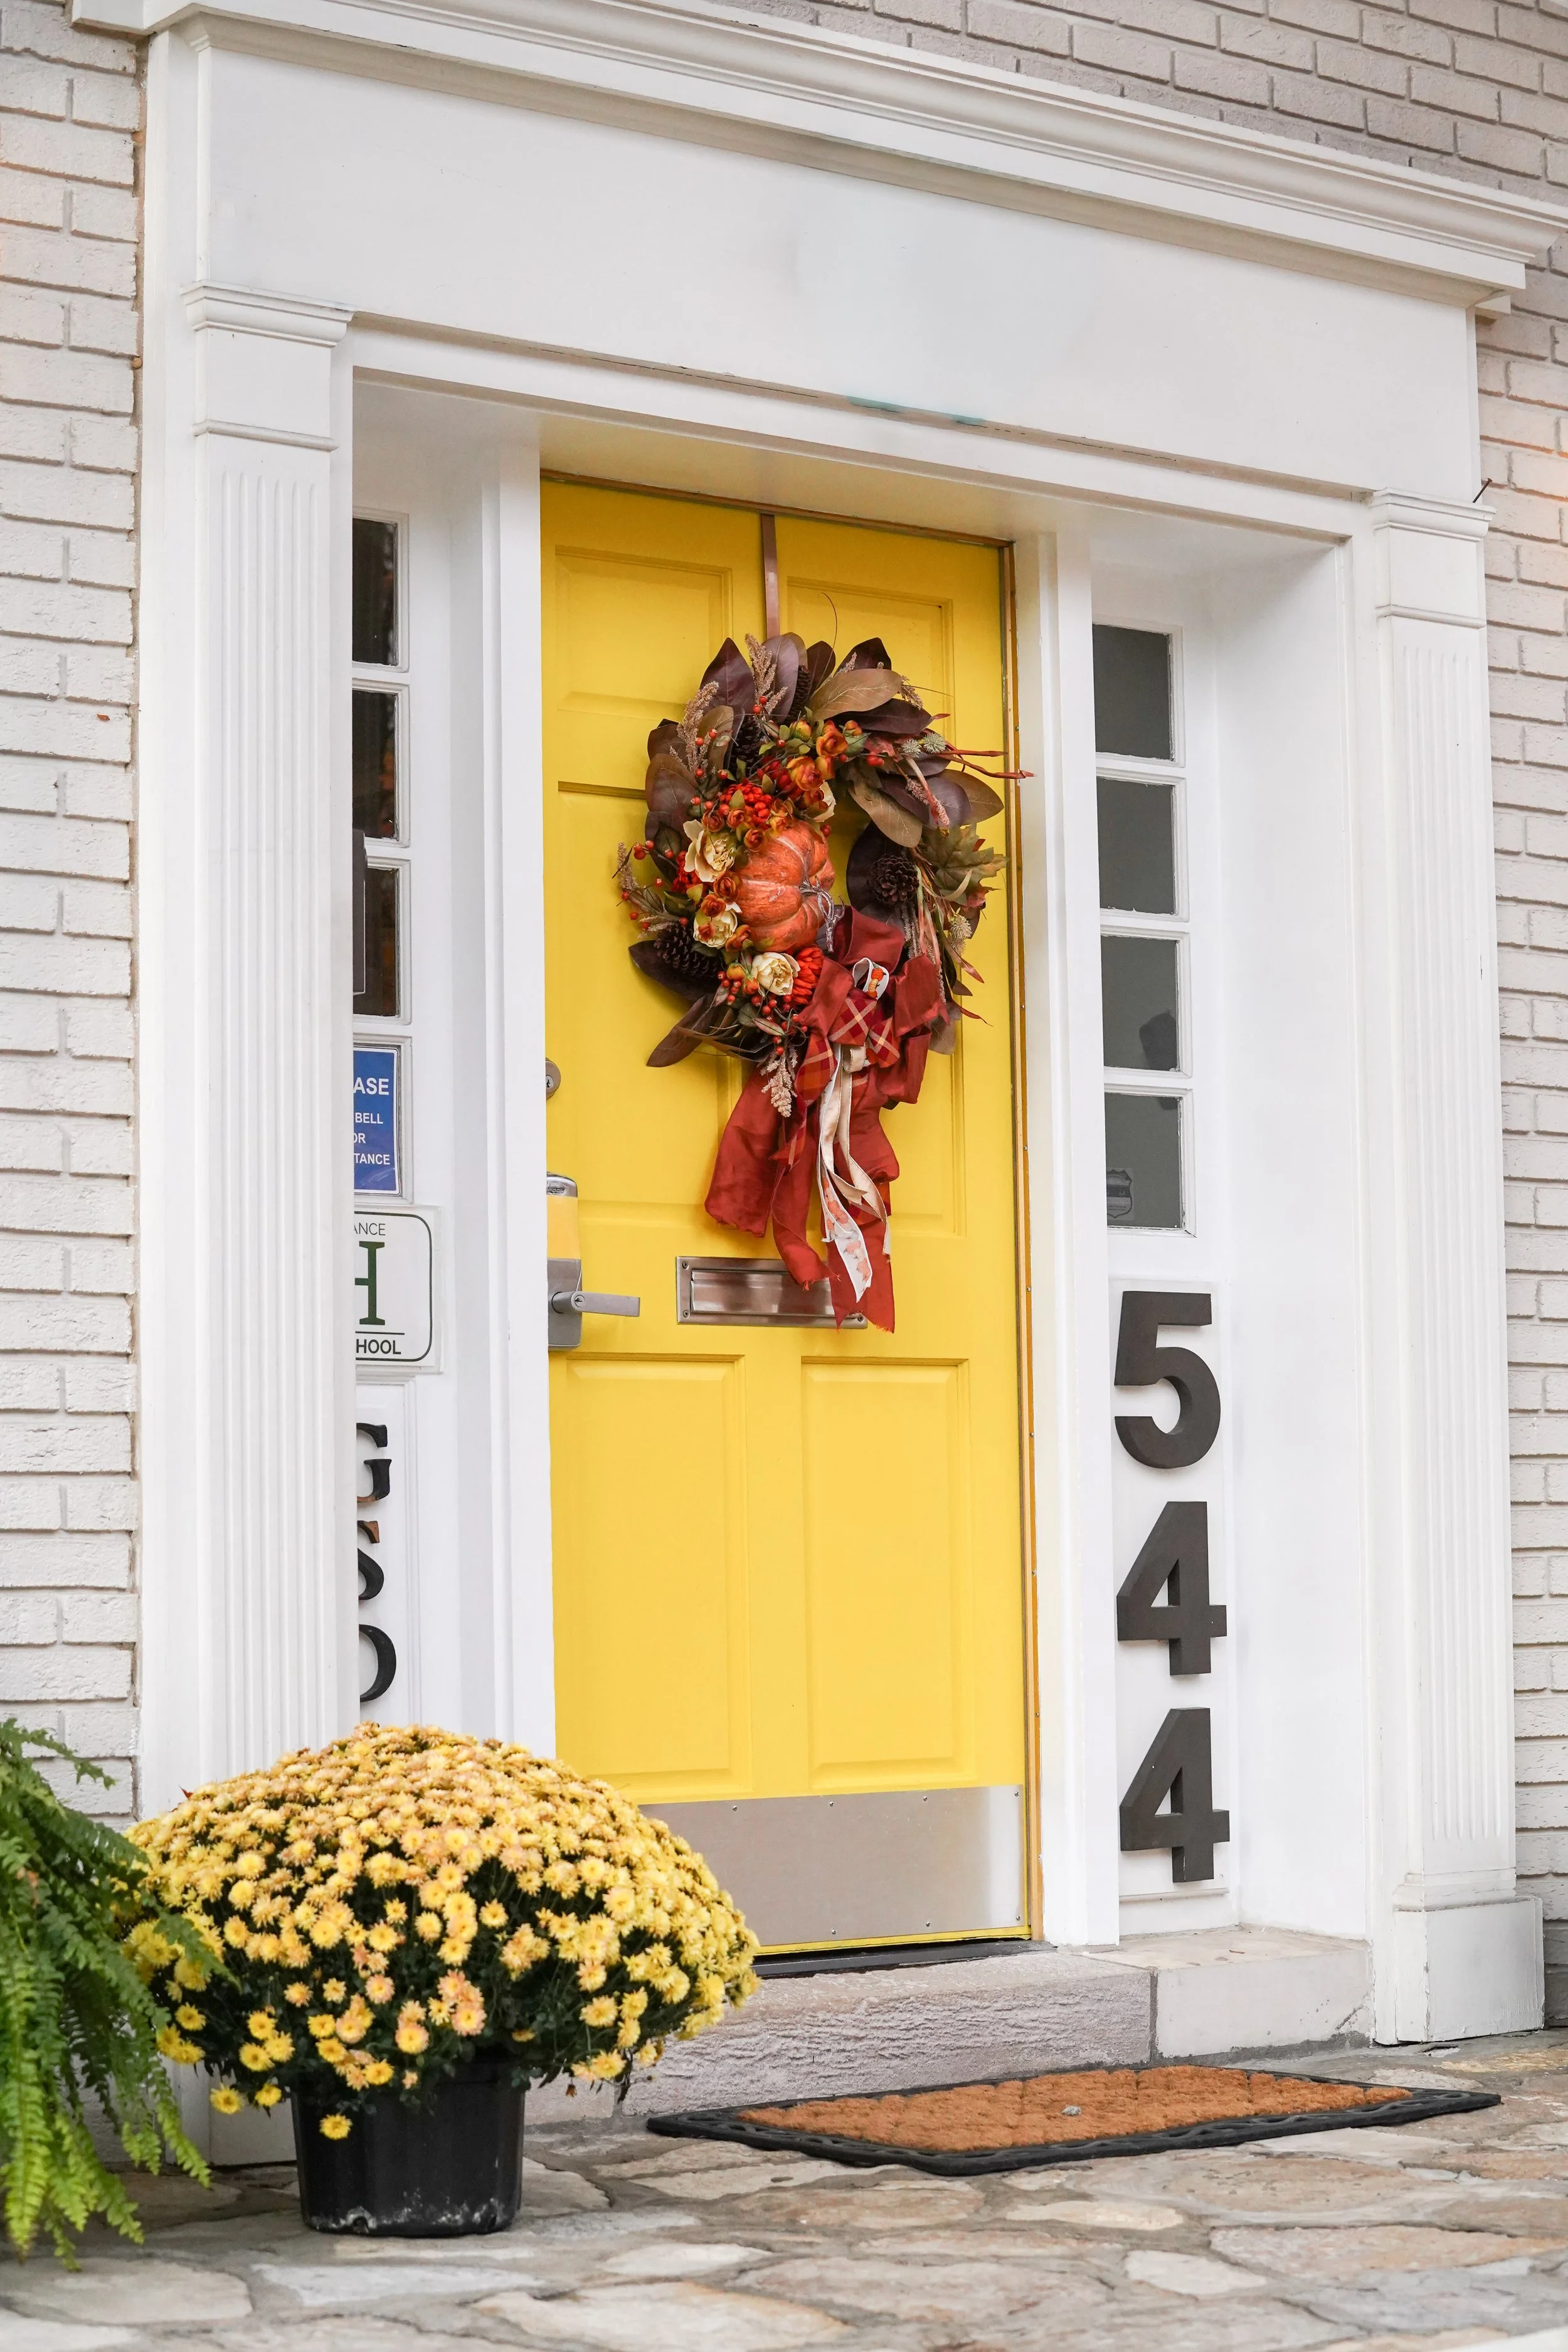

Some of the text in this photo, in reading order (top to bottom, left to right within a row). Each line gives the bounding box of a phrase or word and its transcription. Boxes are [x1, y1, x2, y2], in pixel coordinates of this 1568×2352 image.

[353, 1077, 389, 1095] ASE
[355, 1113, 384, 1124] BELL
[354, 1153, 391, 1165] TANCE
[356, 1338, 401, 1355] HOOL
